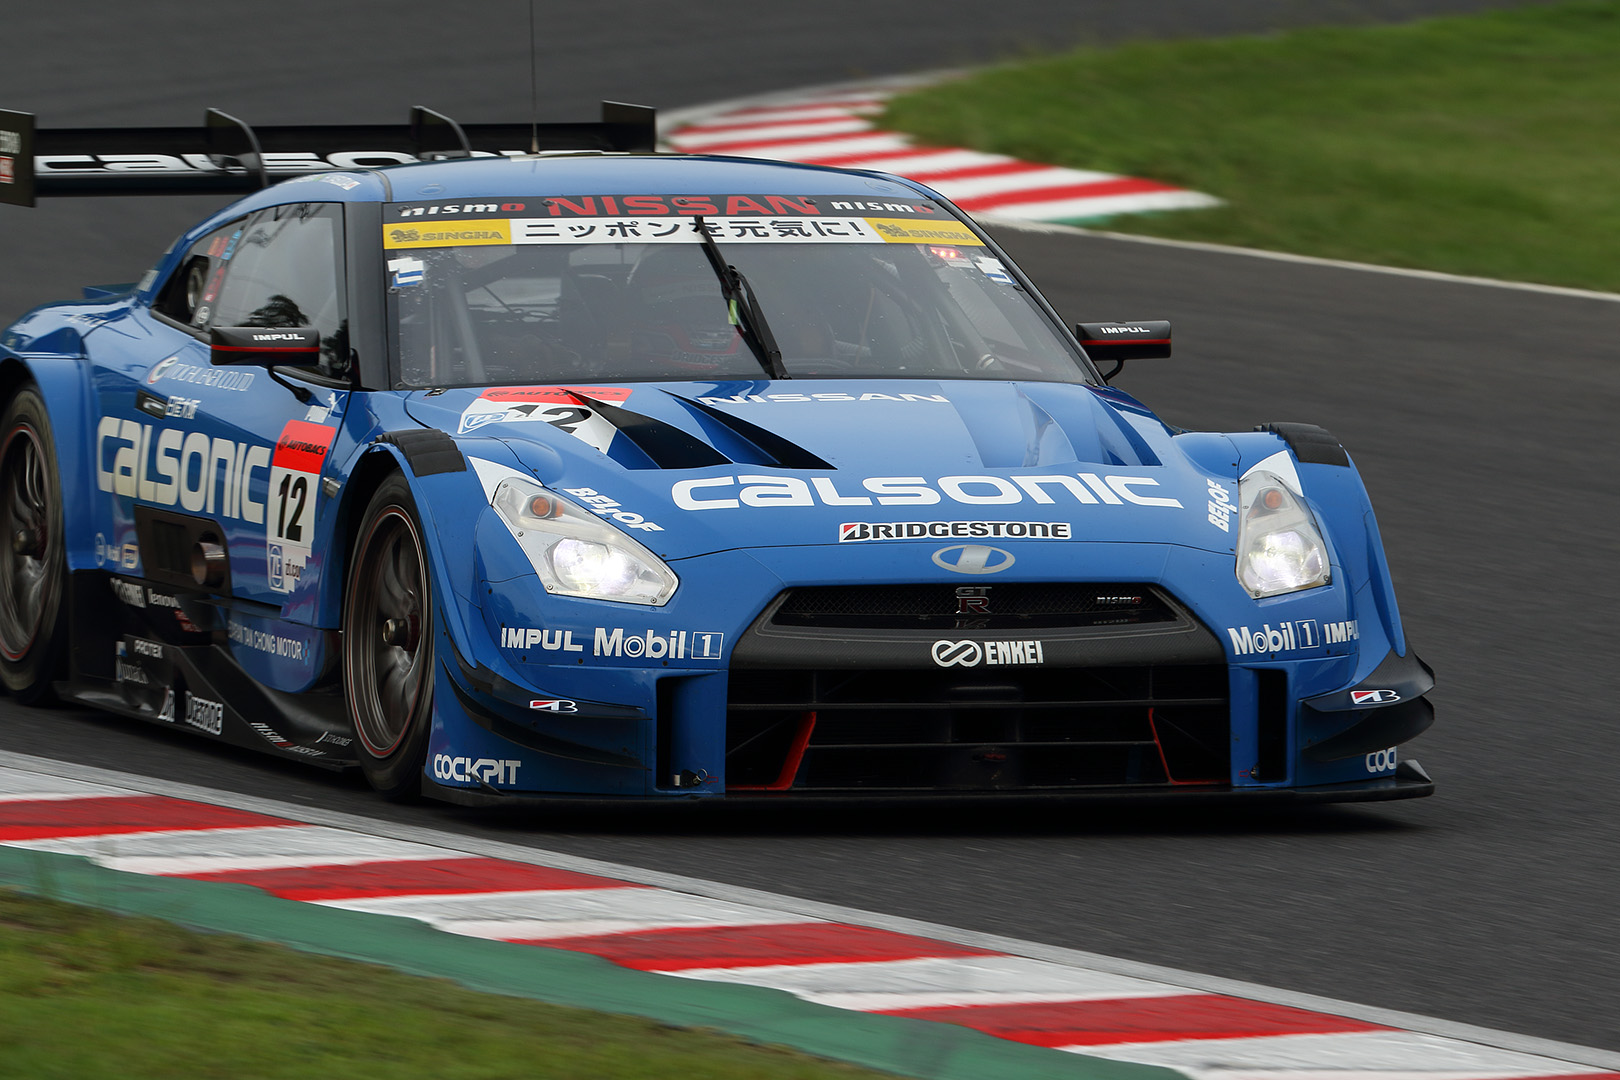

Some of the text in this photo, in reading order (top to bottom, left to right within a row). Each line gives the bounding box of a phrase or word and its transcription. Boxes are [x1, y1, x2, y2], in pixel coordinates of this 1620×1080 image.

[400, 196, 934, 217] nismo NISSAN nismo
[422, 231, 504, 241] SINGHA
[909, 230, 976, 241] SINGHA
[253, 334, 305, 342] IMPUL
[697, 393, 950, 406] NISSAN
[507, 404, 592, 434] 12
[286, 440, 327, 456] AUTOBACS
[277, 473, 308, 543] 12
[842, 523, 1069, 541] BRIDGESTONE
[276, 636, 303, 660] MOTOR
[501, 627, 583, 652] IMPUL
[594, 627, 687, 659] Mobil
[1228, 621, 1296, 656] Mobil
[984, 640, 1044, 665] ENKEI
[434, 753, 521, 785] COCKPIT
